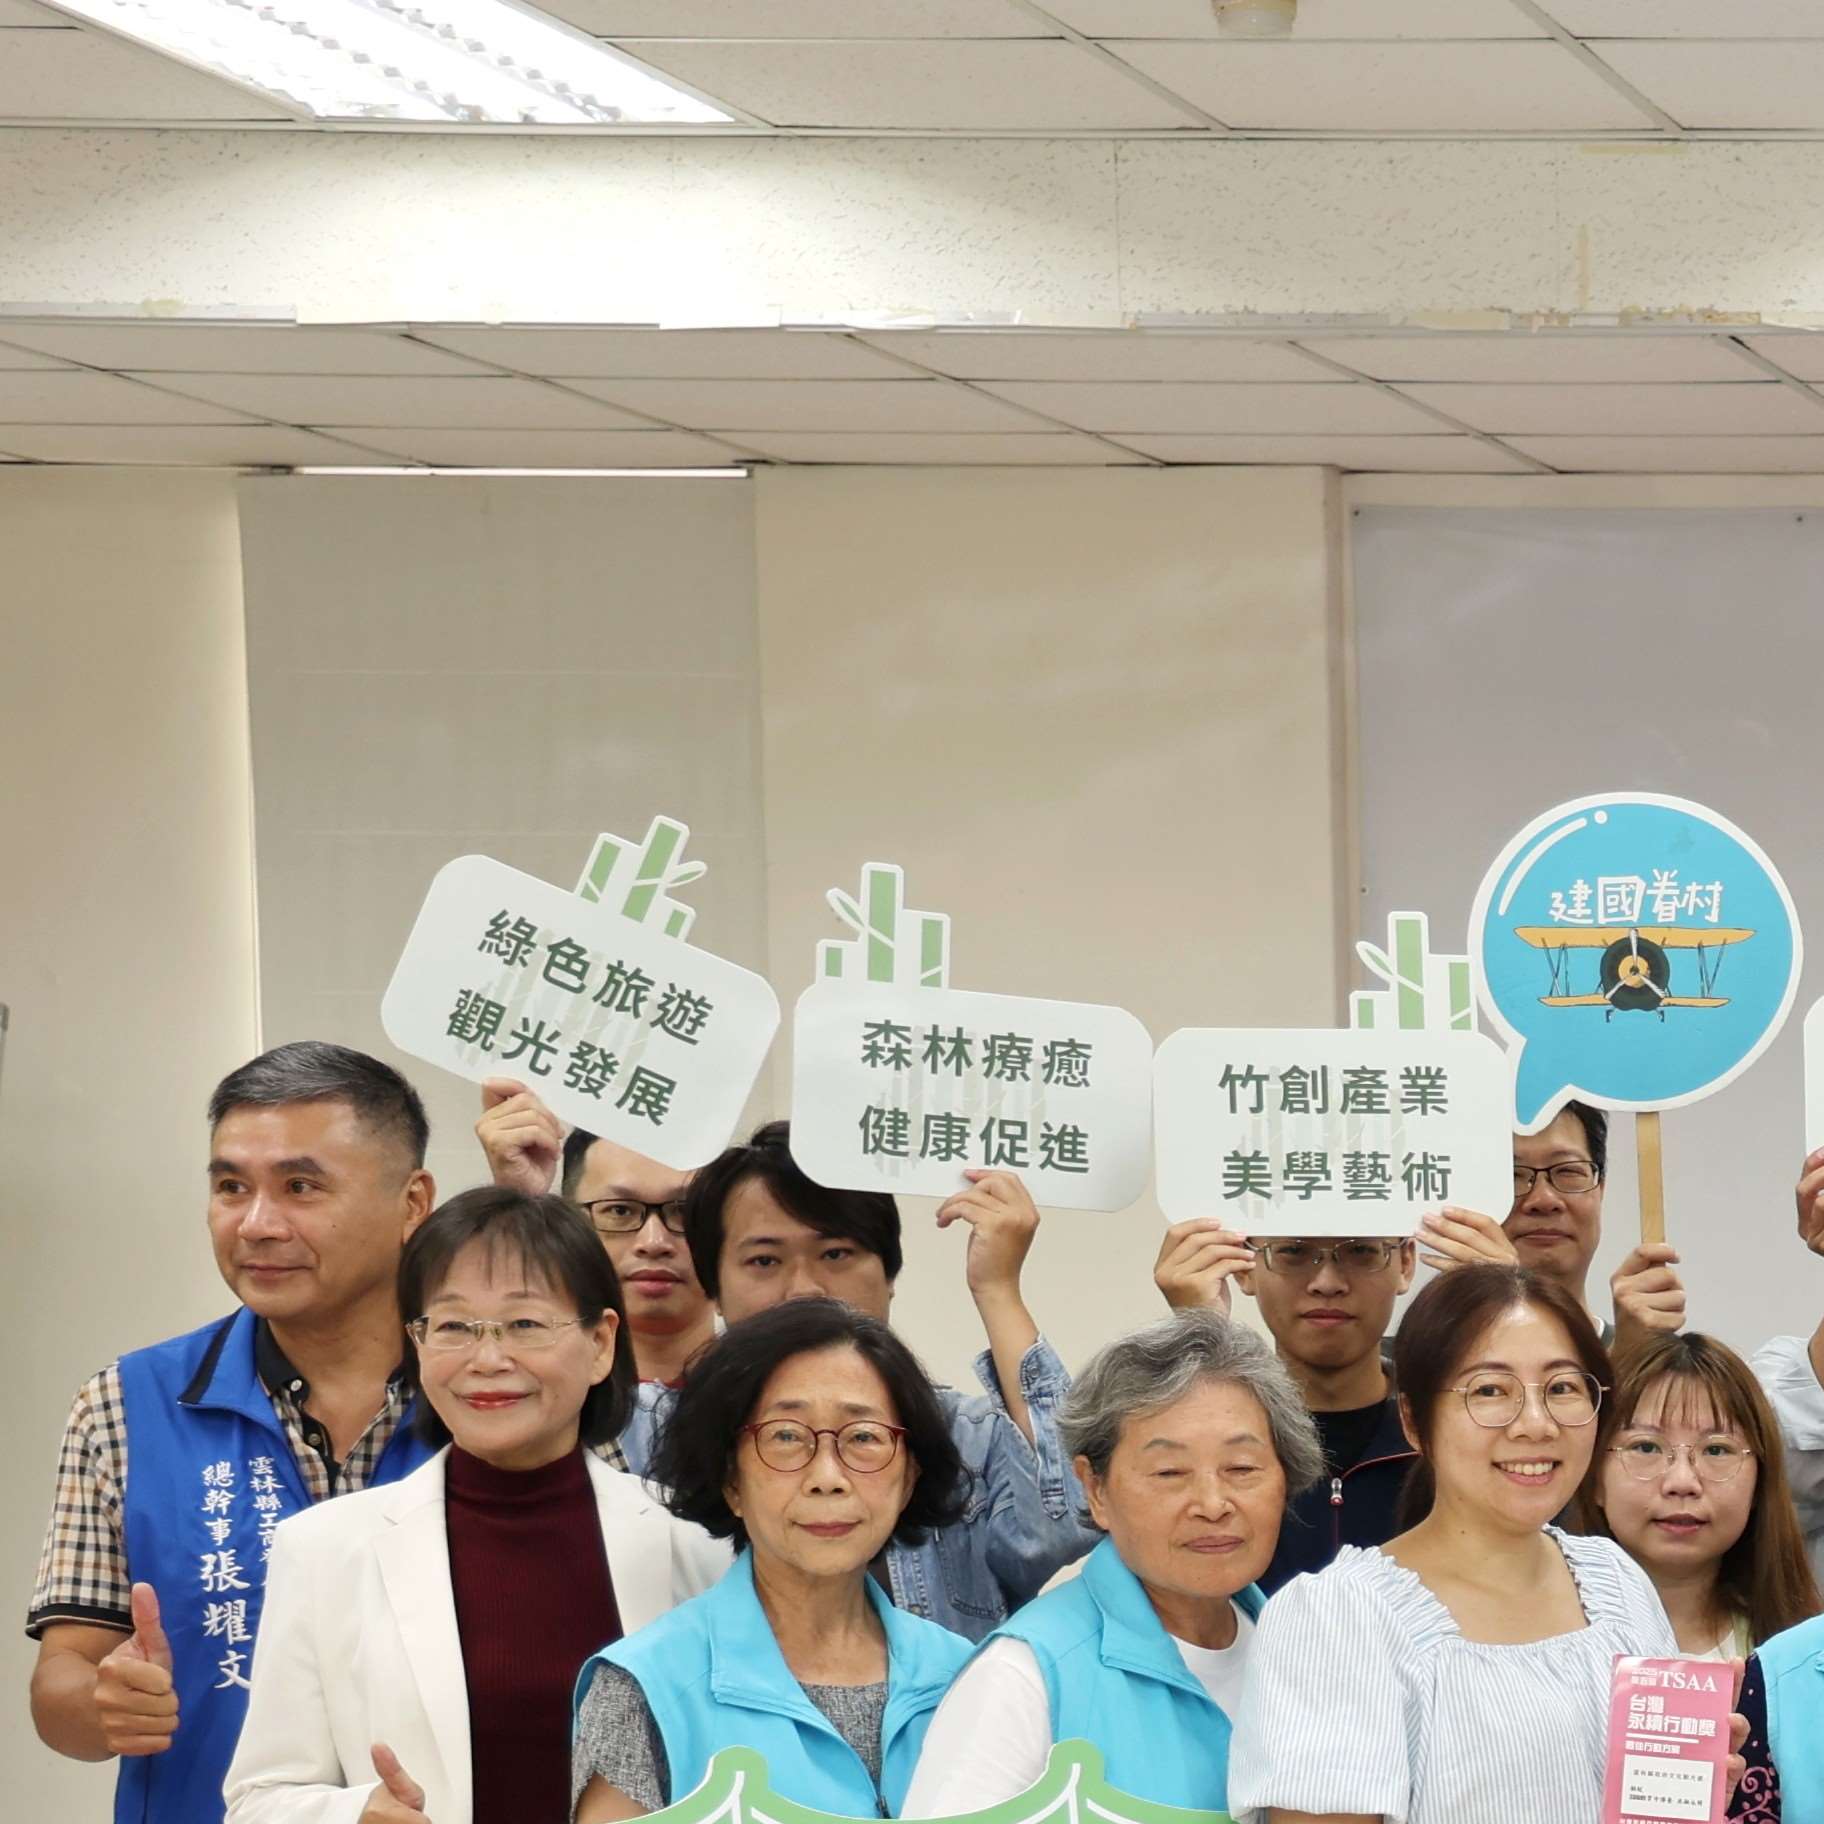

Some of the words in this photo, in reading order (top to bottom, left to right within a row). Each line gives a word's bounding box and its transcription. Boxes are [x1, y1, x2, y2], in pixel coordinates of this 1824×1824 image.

[1548, 869, 1724, 924] 建國眷村
[477, 908, 714, 1047] 綠色旅遊
[446, 987, 678, 1127] 觀光發展
[860, 1019, 1092, 1089] 森林療癒
[1218, 1063, 1449, 1117] 竹創產業
[858, 1104, 1090, 1174] 健康促進
[1222, 1150, 1452, 1202] 美學藝術
[1659, 1671, 1718, 1692] TSAA
